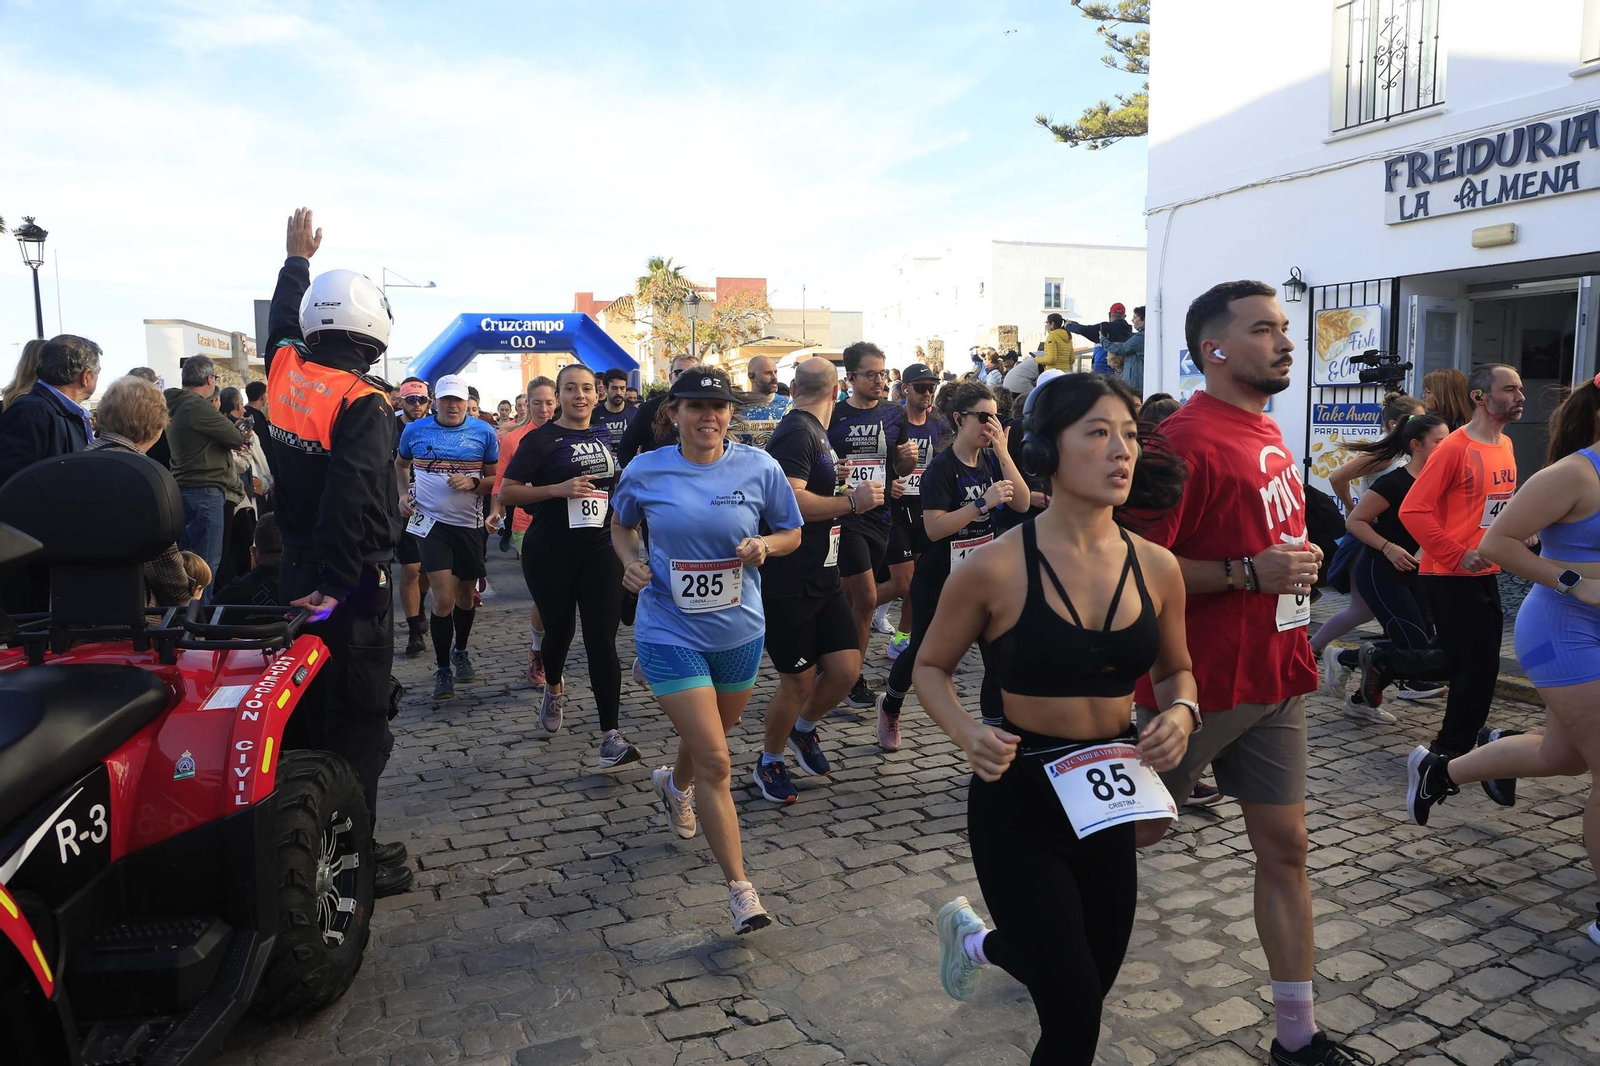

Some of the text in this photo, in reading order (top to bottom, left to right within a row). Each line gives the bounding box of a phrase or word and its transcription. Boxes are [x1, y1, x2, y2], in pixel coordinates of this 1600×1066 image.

[1384, 109, 1600, 192] FREIDURIA
[1399, 160, 1580, 221] LA ALMENA
[481, 317, 564, 334] Cruzcampo
[1349, 328, 1376, 351] Fish
[1316, 404, 1380, 424] Take Away
[848, 424, 878, 437] XVI
[1341, 428, 1378, 436] LLEVAR
[570, 443, 602, 456] XVI
[571, 454, 595, 463] CARRERA
[581, 458, 606, 467] ESTRECHO
[851, 467, 875, 481] 467
[908, 475, 920, 487] 42
[581, 500, 599, 516] 86
[682, 573, 724, 597] 285
[233, 656, 296, 805] PROTECCION CIVIL
[1086, 763, 1136, 801] 85
[1108, 799, 1136, 809] CRISTINA
[56, 804, 108, 864] R-3
